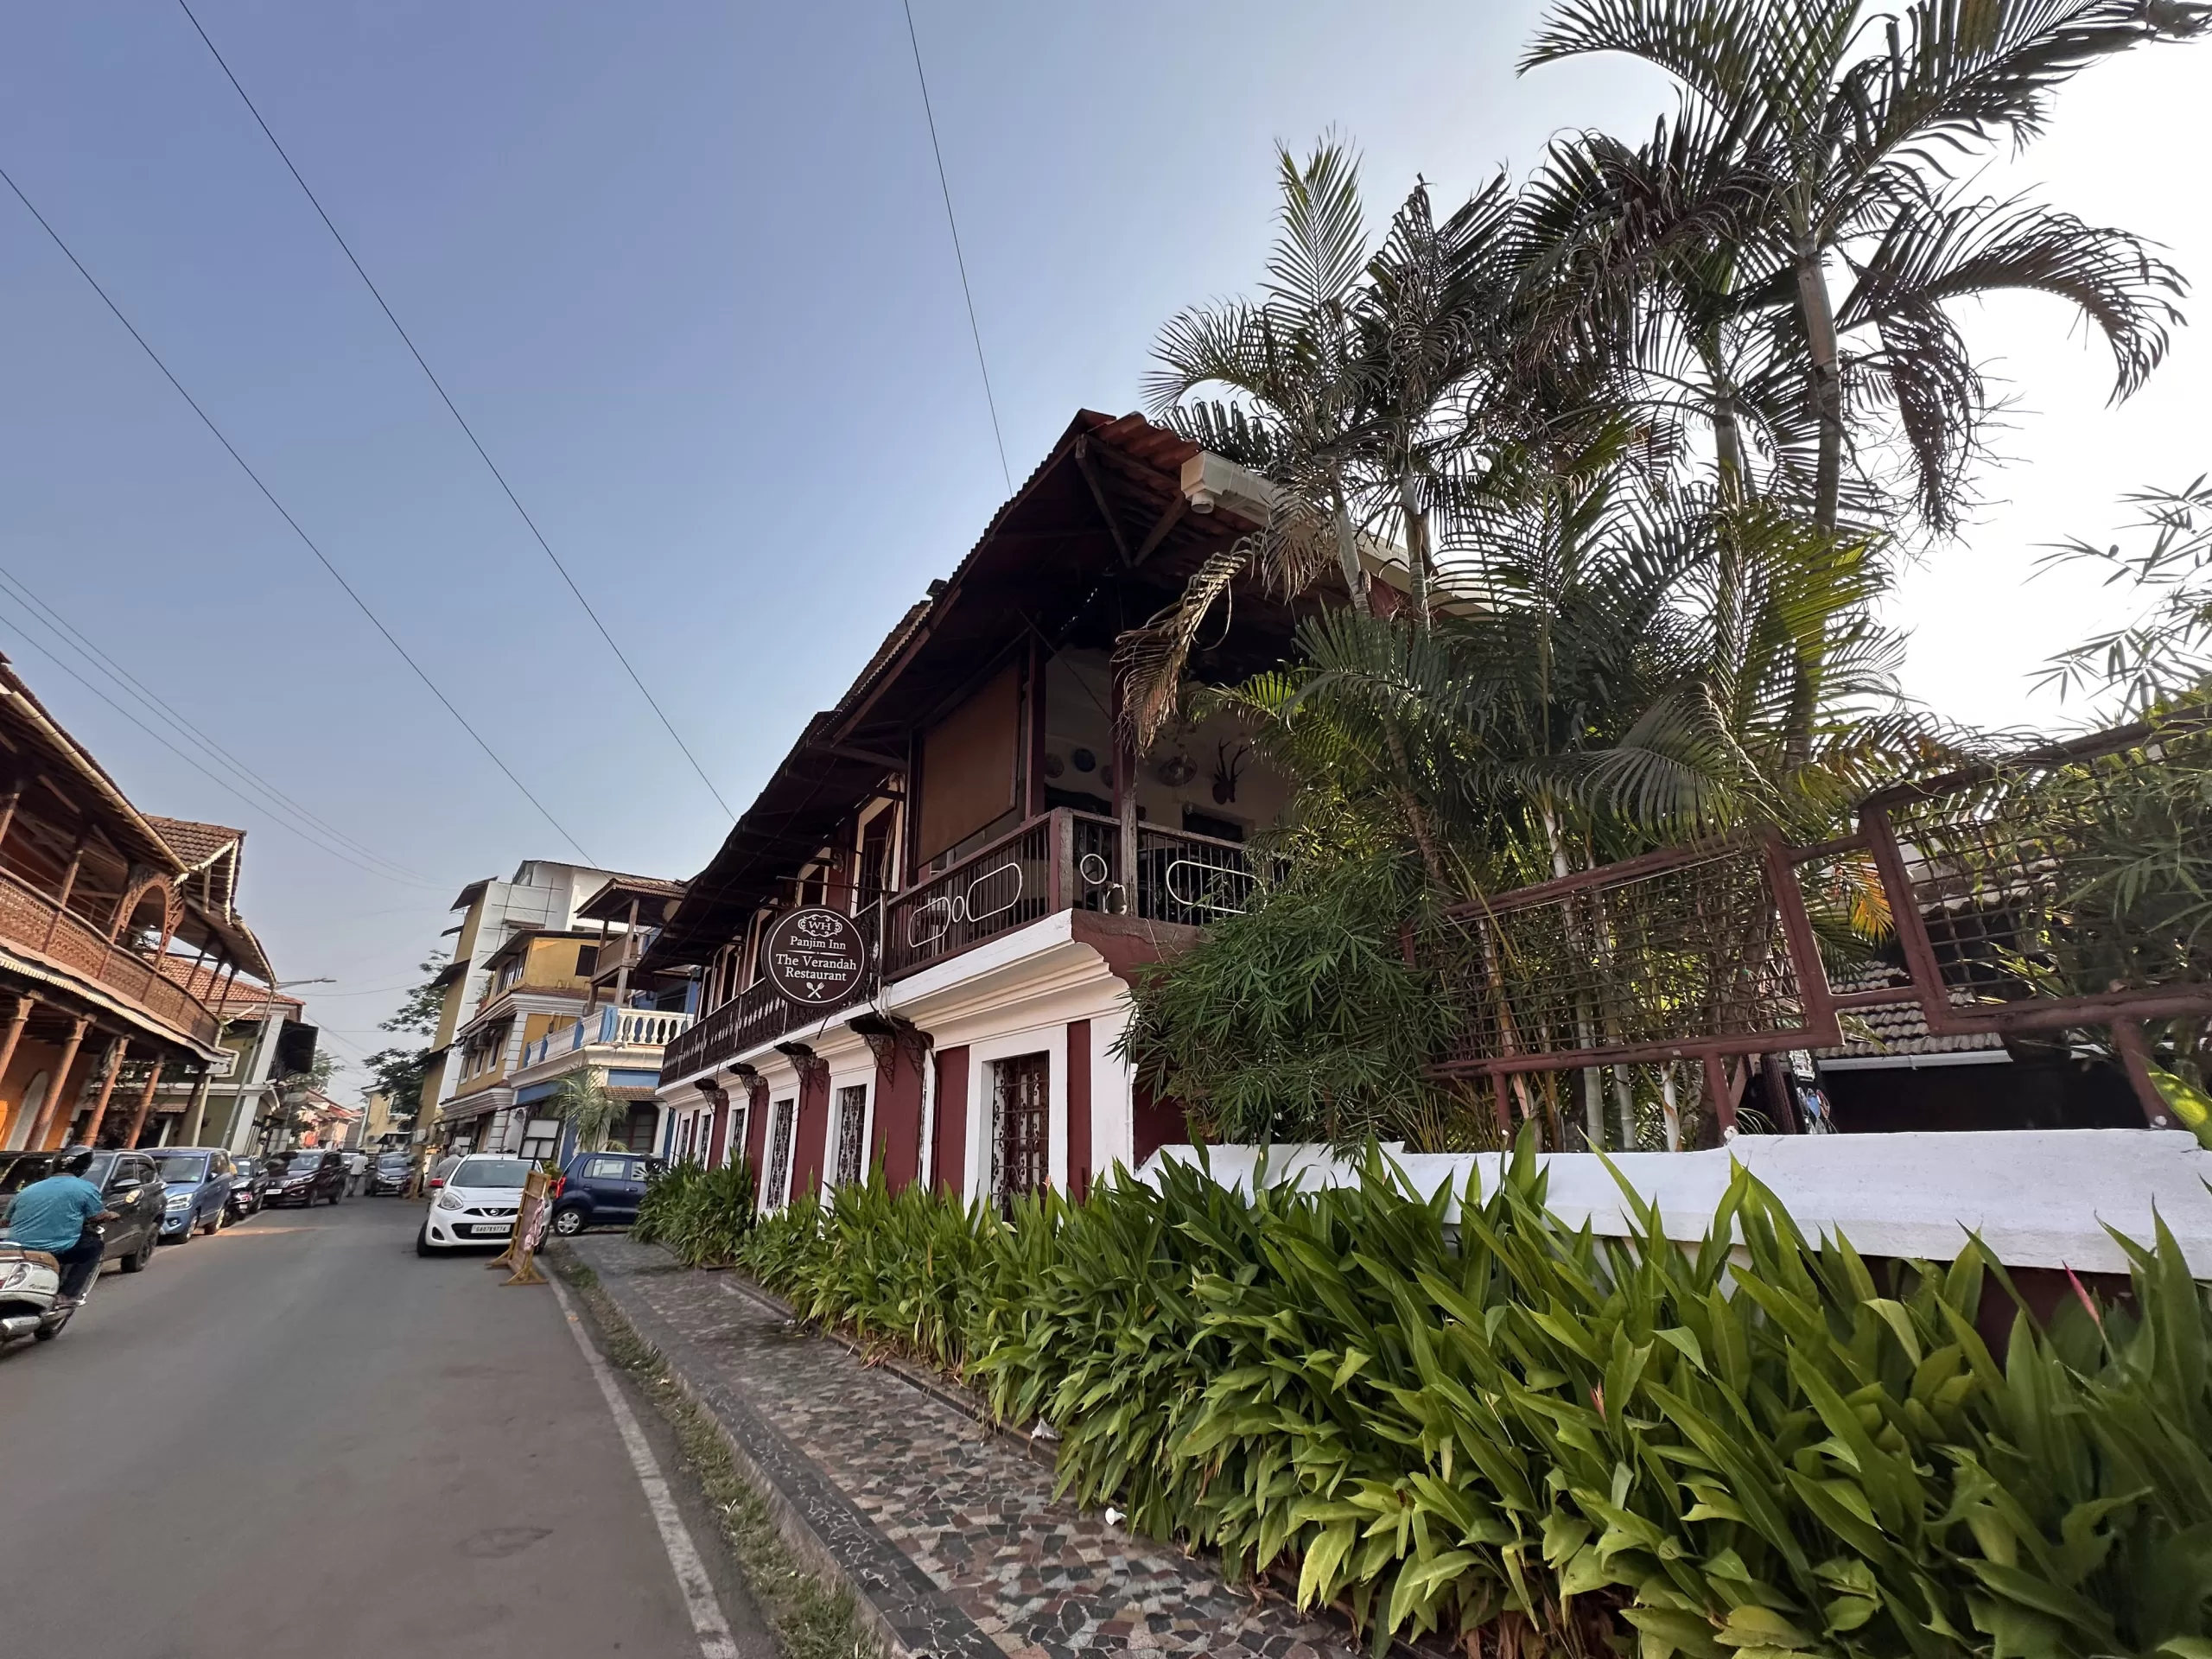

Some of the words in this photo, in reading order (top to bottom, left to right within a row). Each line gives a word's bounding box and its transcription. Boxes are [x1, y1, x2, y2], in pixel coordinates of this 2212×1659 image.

[808, 920, 831, 931] WH
[790, 936, 825, 949] Panjim
[829, 939, 846, 950] Inn
[776, 954, 798, 965] The
[802, 956, 856, 970] Verandah
[785, 966, 847, 981] Restaurant
